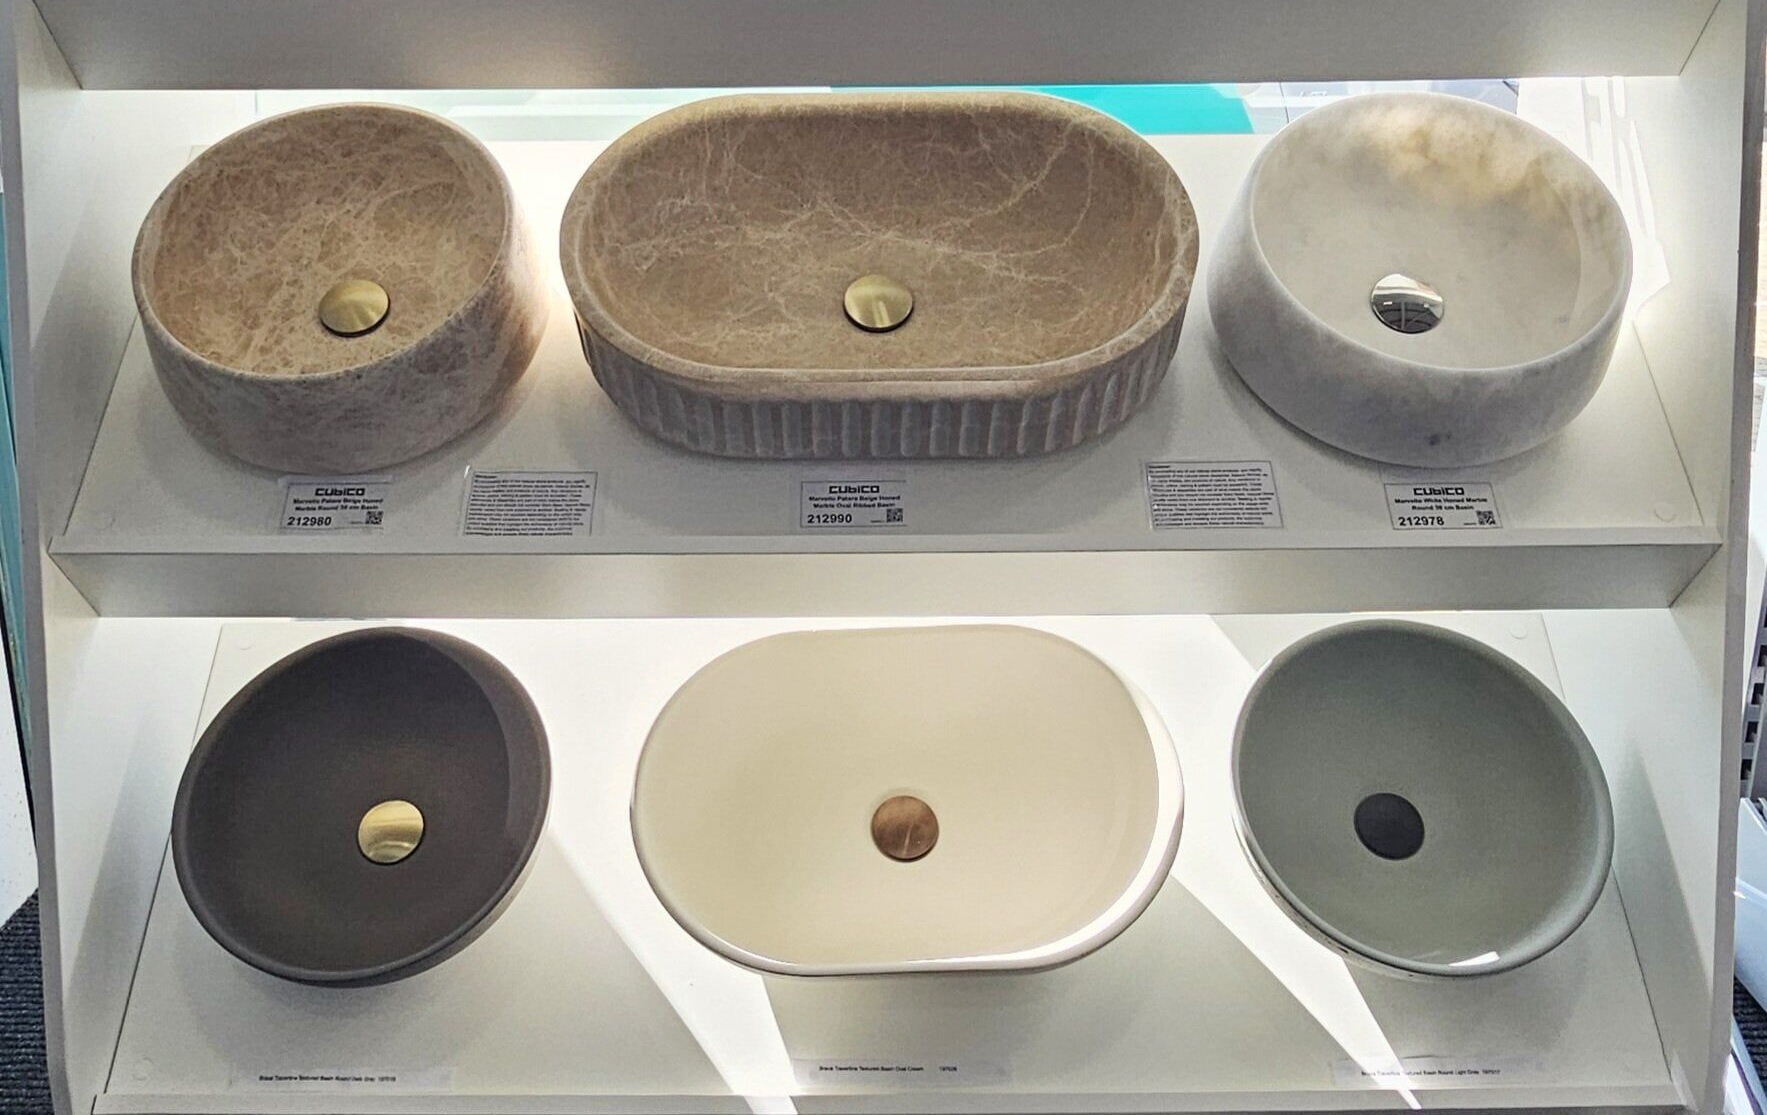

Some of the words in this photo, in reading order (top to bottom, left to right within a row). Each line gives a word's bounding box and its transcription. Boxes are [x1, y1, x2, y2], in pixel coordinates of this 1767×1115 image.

[287, 516, 332, 526] 212980
[807, 514, 853, 523] 212990
[1398, 516, 1445, 526] 212978
